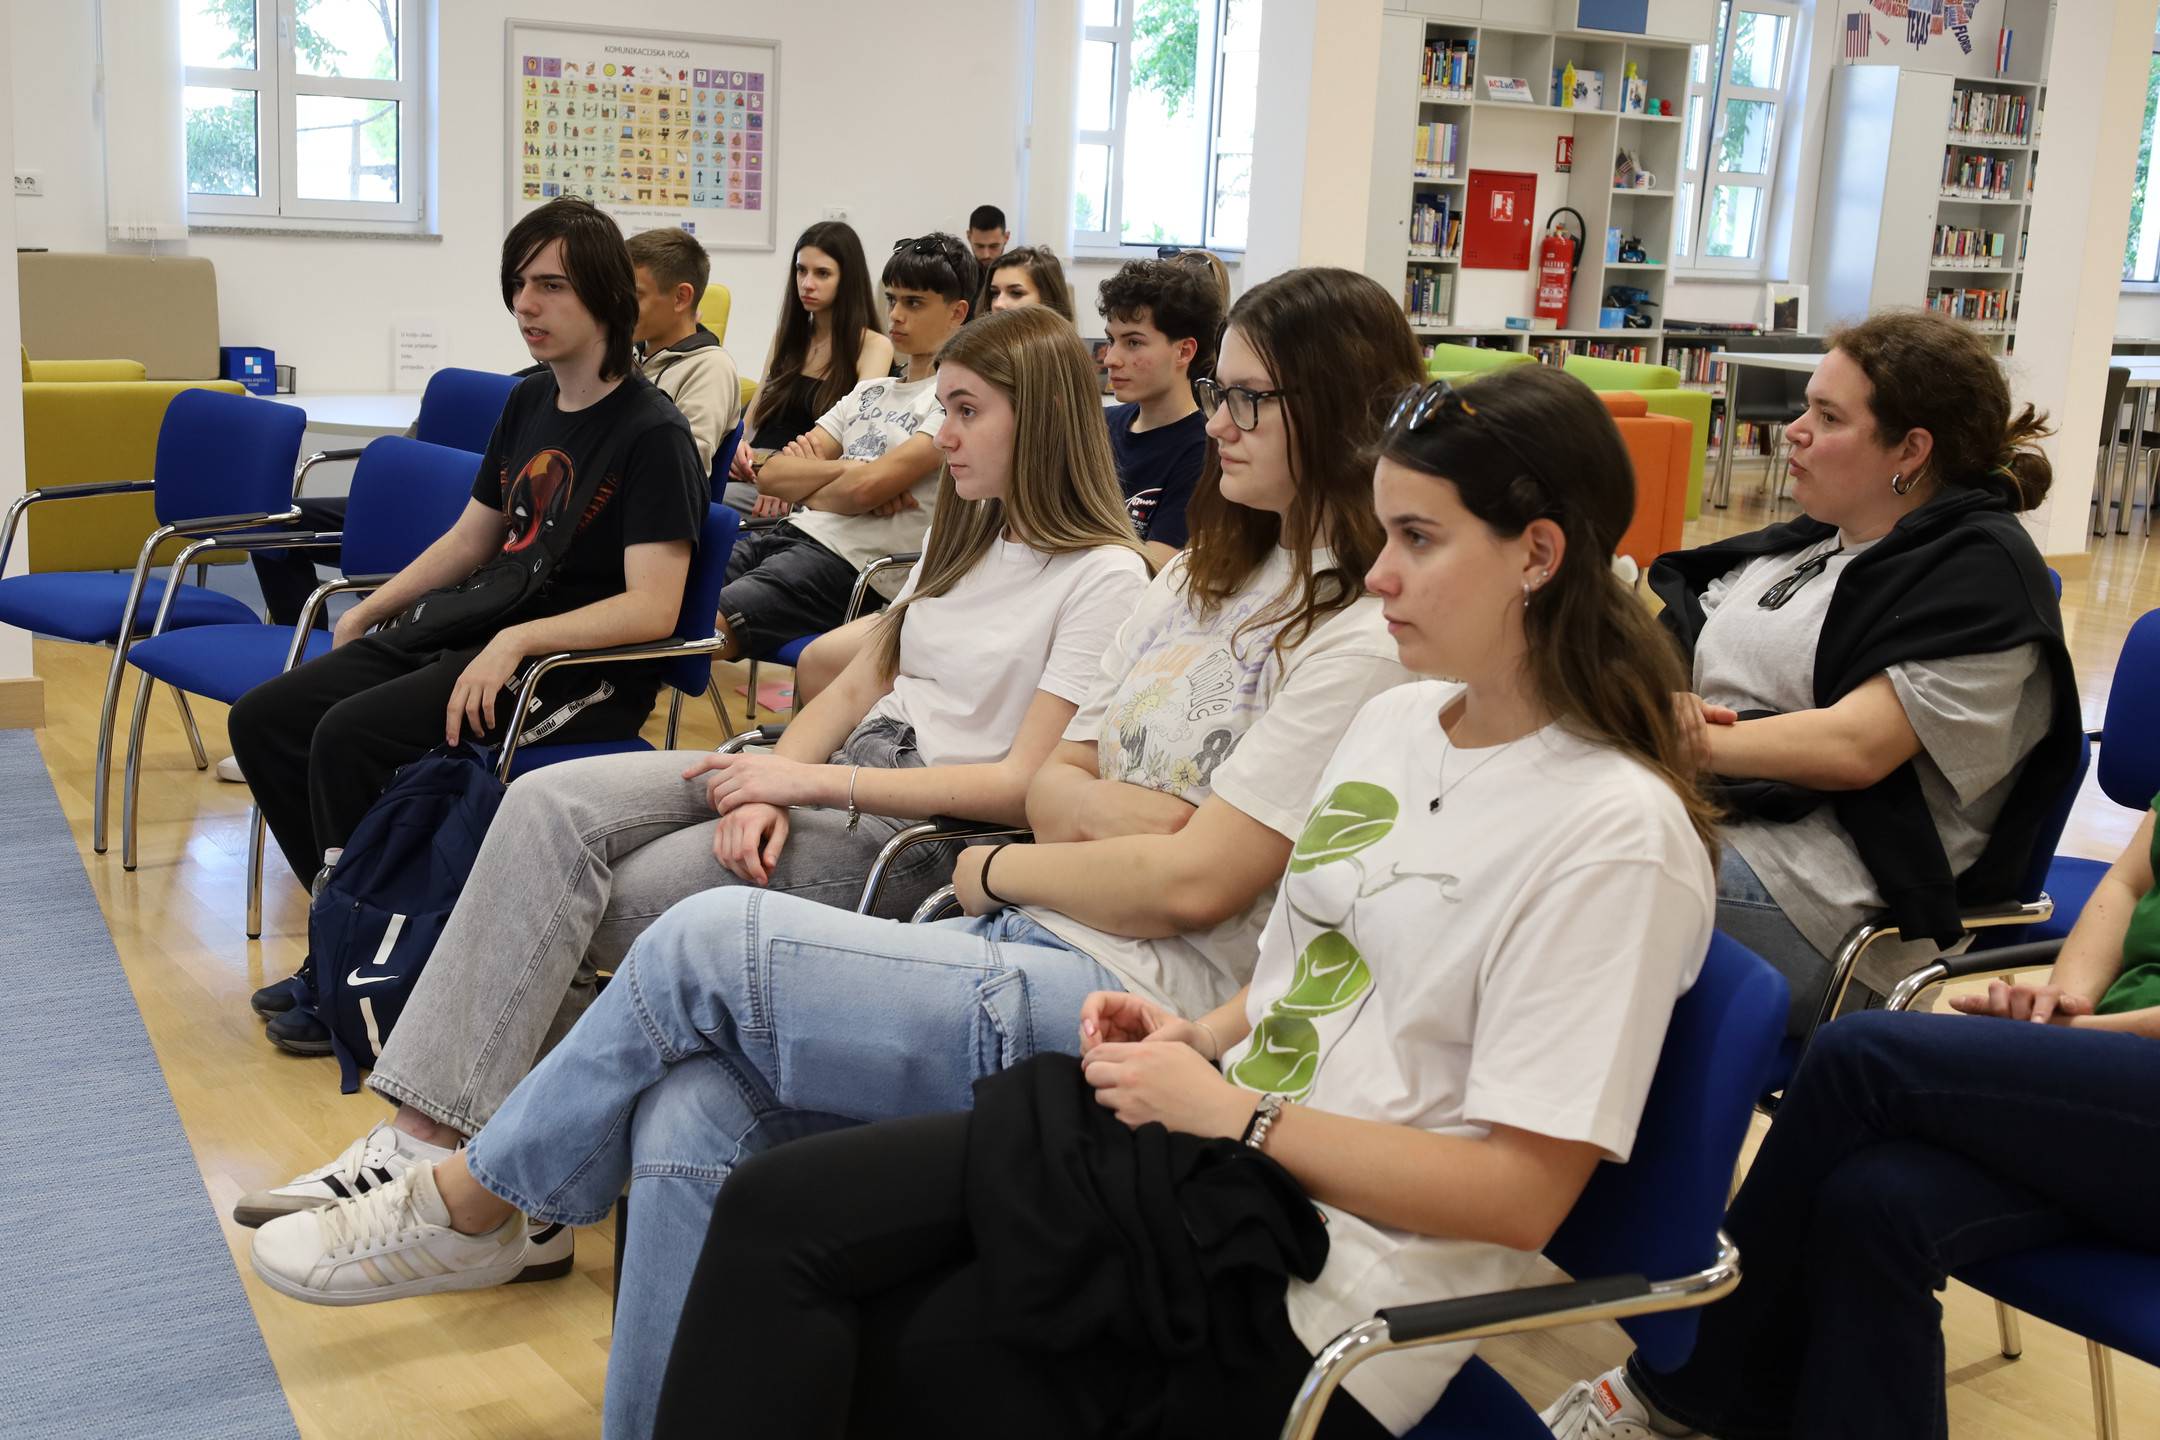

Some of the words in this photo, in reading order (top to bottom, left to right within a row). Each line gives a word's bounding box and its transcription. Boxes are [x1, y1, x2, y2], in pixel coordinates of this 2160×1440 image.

[1906, 9, 1931, 51] TEXAS
[604, 45, 666, 57] KOMUNIKACIJSKA
[667, 47, 690, 59] PLOČA
